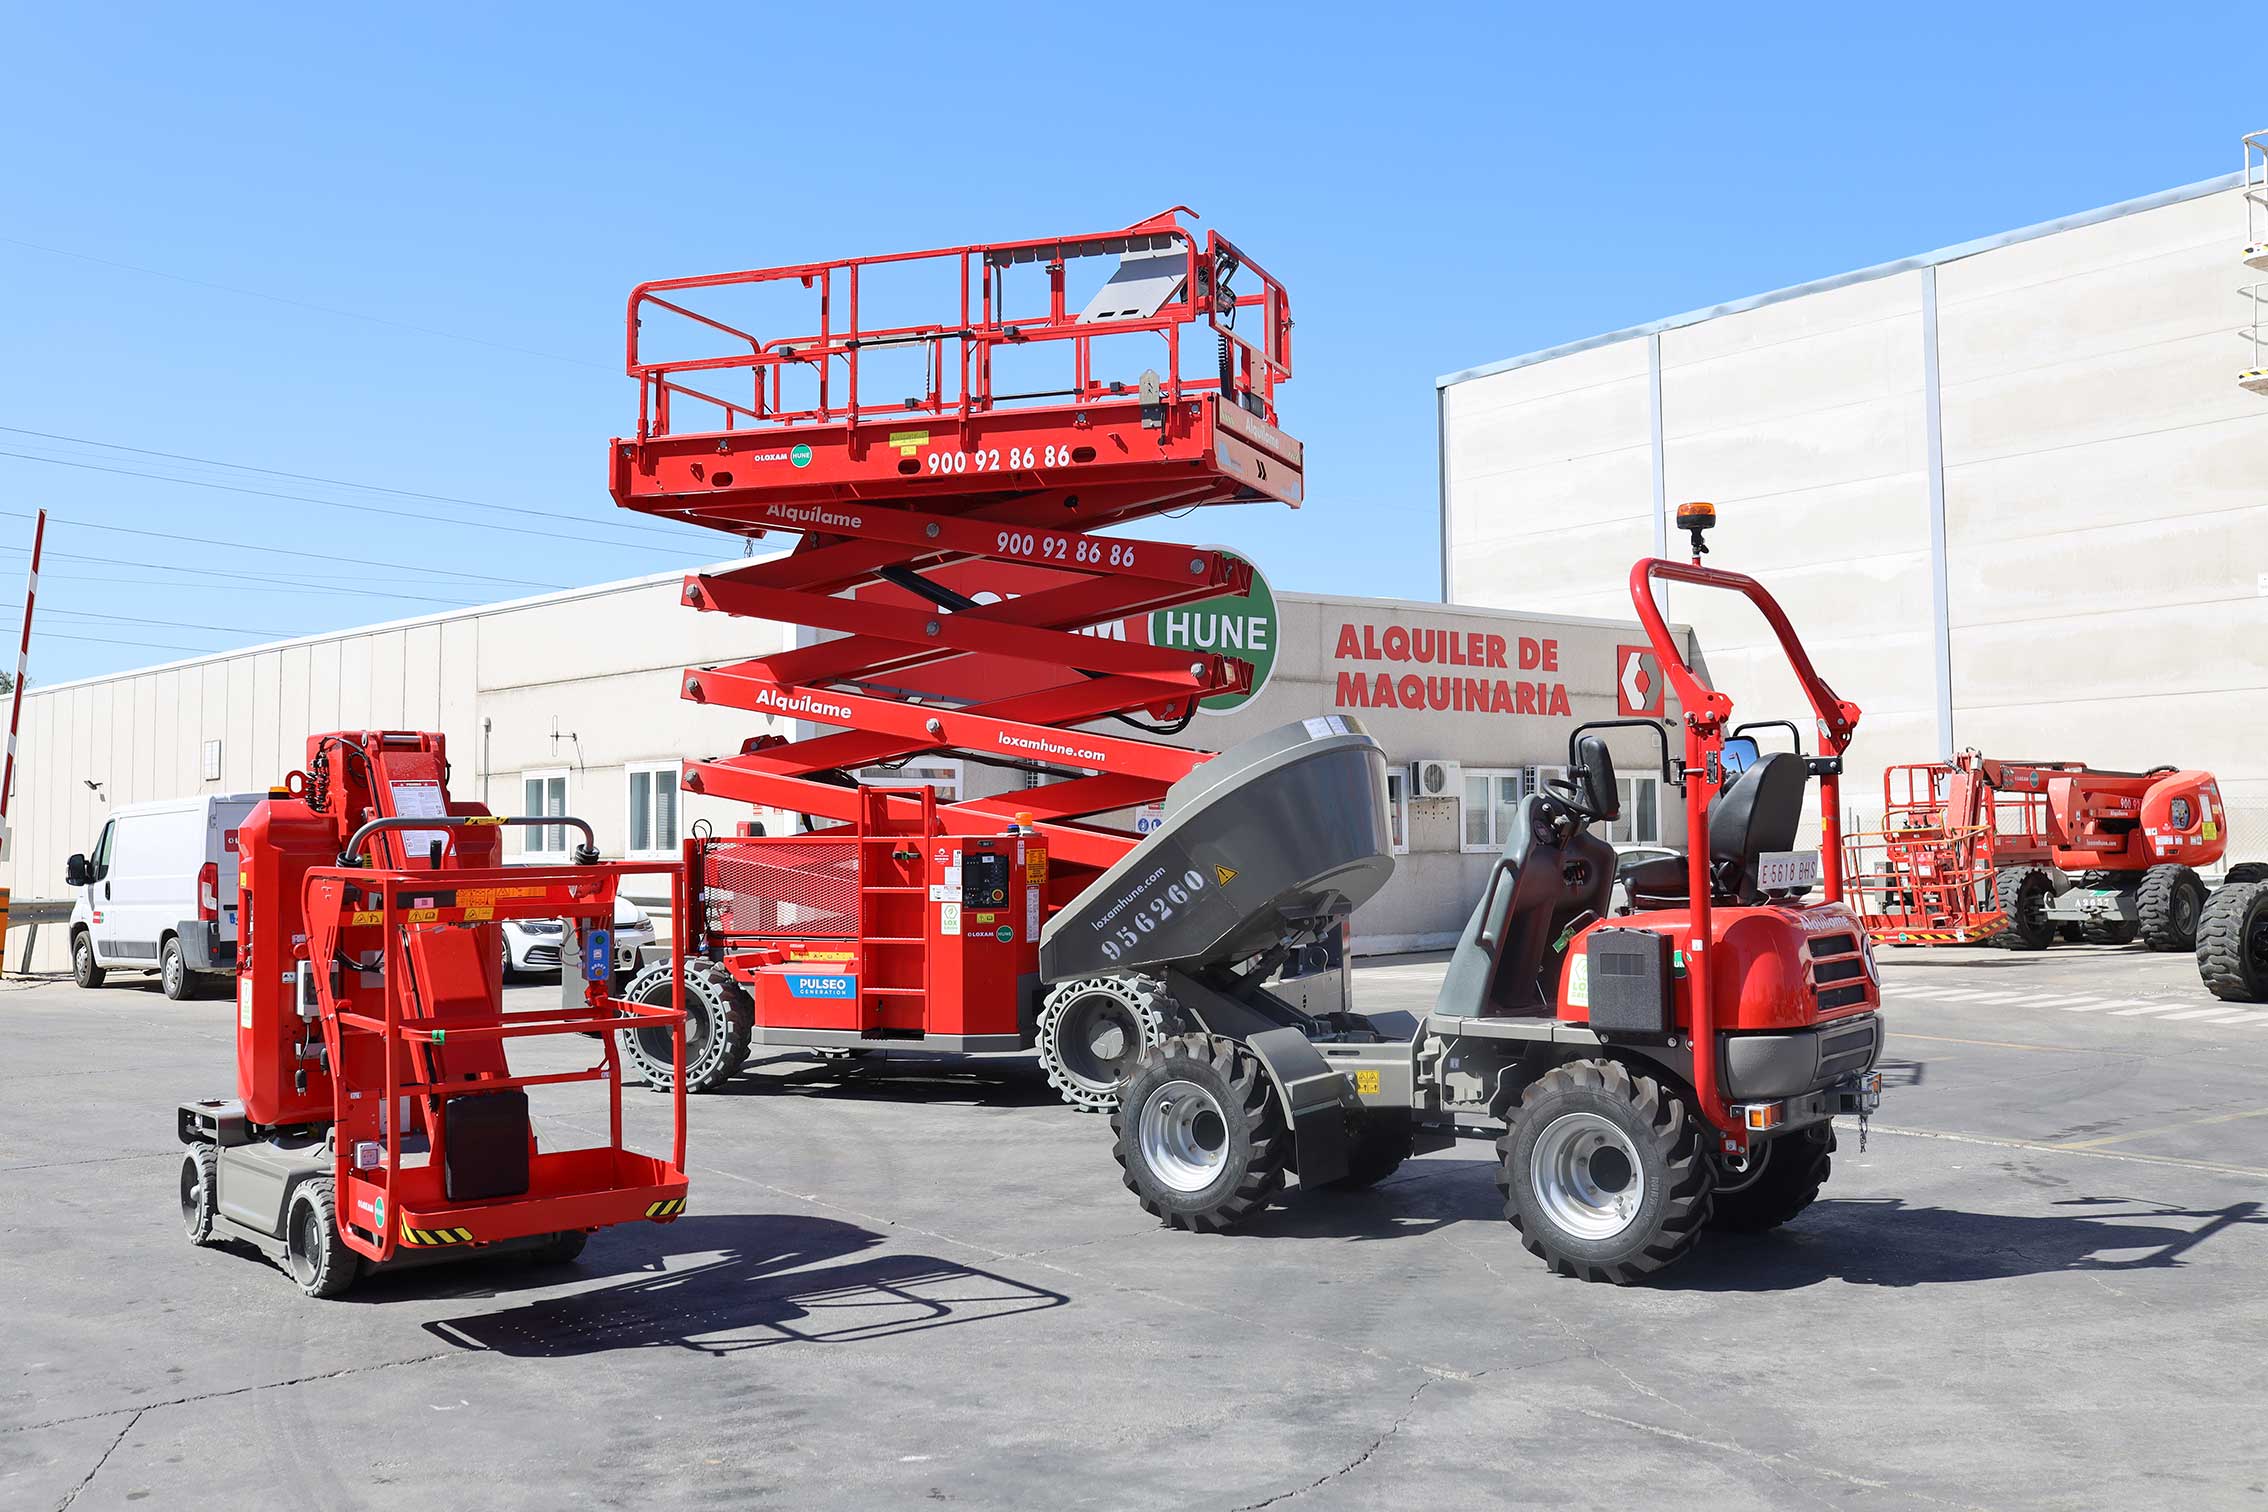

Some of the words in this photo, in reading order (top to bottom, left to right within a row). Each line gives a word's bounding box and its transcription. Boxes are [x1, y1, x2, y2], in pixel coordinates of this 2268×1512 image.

[927, 451, 967, 475] 900
[975, 448, 1000, 472] 92
[1009, 447, 1035, 470] 86
[1044, 445, 1070, 468] 86
[766, 504, 862, 529] Alquílame
[997, 531, 1035, 556] 900
[1042, 536, 1068, 560] 92
[1075, 540, 1101, 564] 86
[1109, 544, 1135, 567] 86
[1166, 611, 1267, 651] HUNE
[1334, 623, 1508, 669] ALQUILER
[1518, 636, 1558, 672] DE
[755, 689, 852, 719] Alquílame
[1335, 671, 1572, 717] MAQUINARIA
[998, 731, 1106, 762] loxamhune.com
[1762, 865, 1768, 884] E
[1771, 863, 1795, 883] 5618
[1090, 866, 1166, 931] loxamhune.com
[1101, 870, 1204, 960] 956260
[800, 978, 846, 989] PULSEO
[1573, 982, 1587, 991] LO
